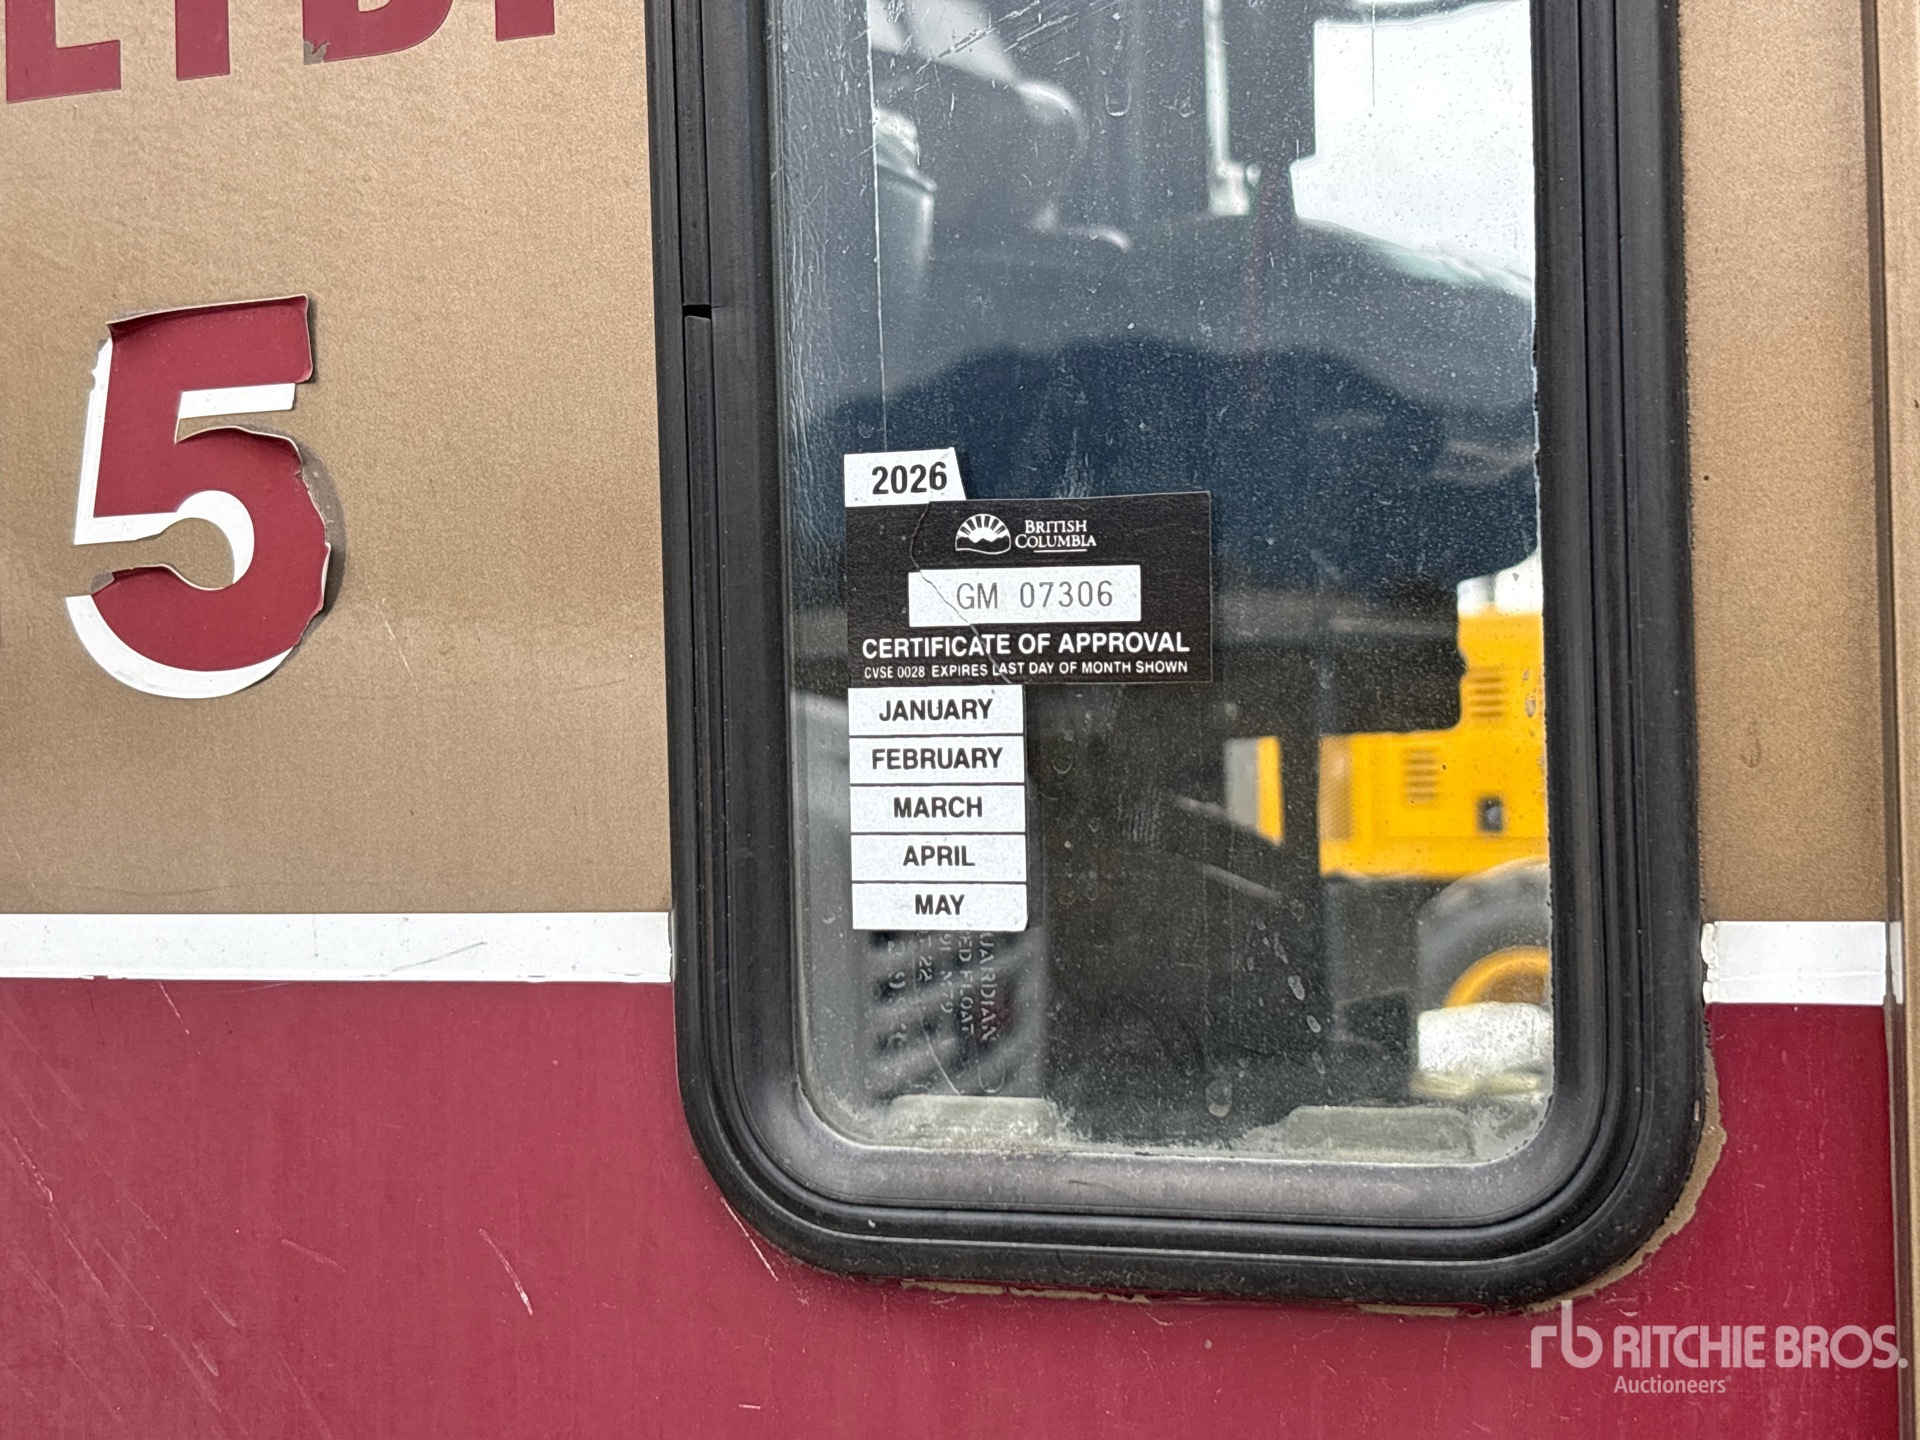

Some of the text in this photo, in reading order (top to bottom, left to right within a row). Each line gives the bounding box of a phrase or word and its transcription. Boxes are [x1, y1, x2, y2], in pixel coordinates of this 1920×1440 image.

[872, 462, 948, 494] 2026
[66, 294, 331, 699] 5
[1025, 519, 1088, 533] BRITISH
[1014, 532, 1097, 549] COLUMBIA
[956, 580, 1113, 610] GM 07306
[862, 631, 1191, 659] CERTIFICATE OF APPROVAL
[864, 660, 1188, 679] CVSE 0028 EXPIRES LAST DAY OF MONTH SHOWN
[879, 699, 993, 722] JANUARY
[872, 747, 1003, 770] FEBRUARY
[893, 796, 983, 819] MARCH
[903, 845, 976, 867] APRIL
[915, 894, 965, 916] MAY
[978, 931, 999, 1042] UARDIAN
